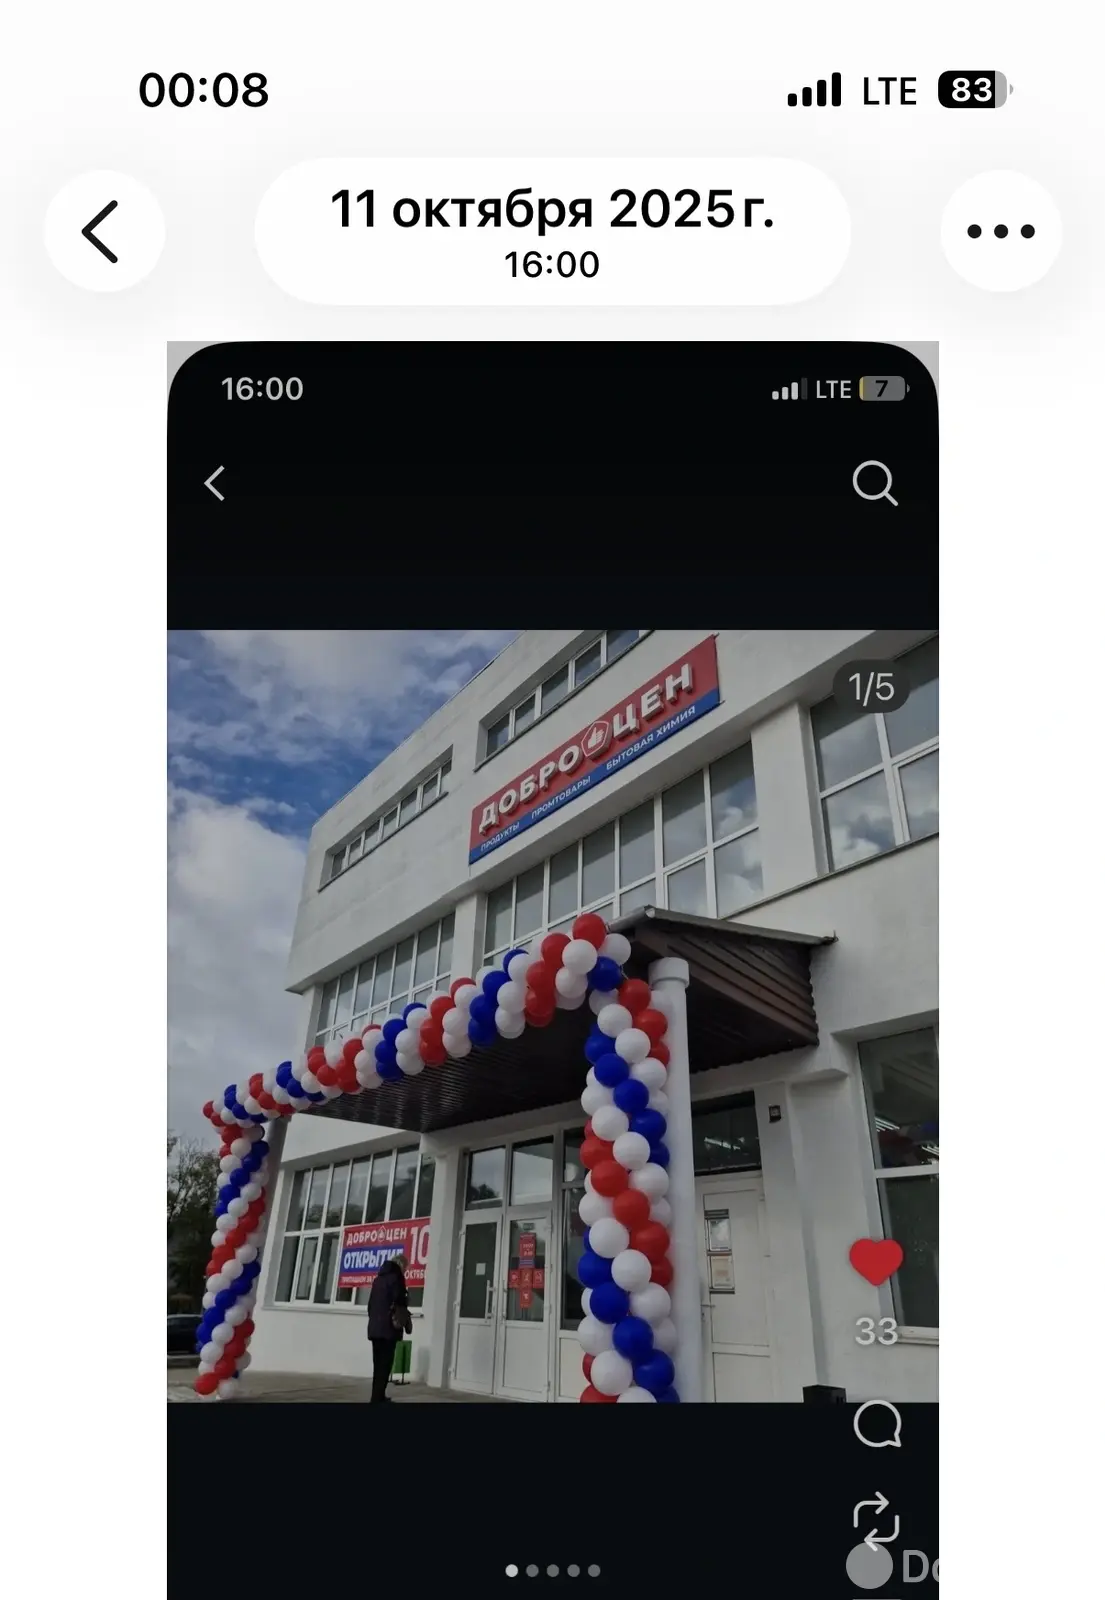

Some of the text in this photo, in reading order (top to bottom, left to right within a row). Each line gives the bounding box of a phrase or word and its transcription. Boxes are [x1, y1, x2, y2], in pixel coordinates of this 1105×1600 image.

[140, 73, 268, 107] 00:08
[864, 77, 916, 105] LTE
[952, 78, 992, 102] 83
[332, 190, 374, 228] 11
[393, 187, 593, 236] октября
[611, 189, 735, 228] 2025
[506, 250, 600, 279] 16:00
[222, 377, 304, 401] 16:00
[816, 380, 852, 399] LTE
[875, 380, 889, 398] 7
[848, 671, 895, 707] 1/5
[480, 705, 696, 852] ПРОДУКТЫ ПРОМТОВАРЫ БЫТОВАЯ ХИМИЯ
[410, 1224, 430, 1265] 10
[404, 1269, 425, 1280] ОКТЯБ
[856, 1318, 898, 1345] 33
